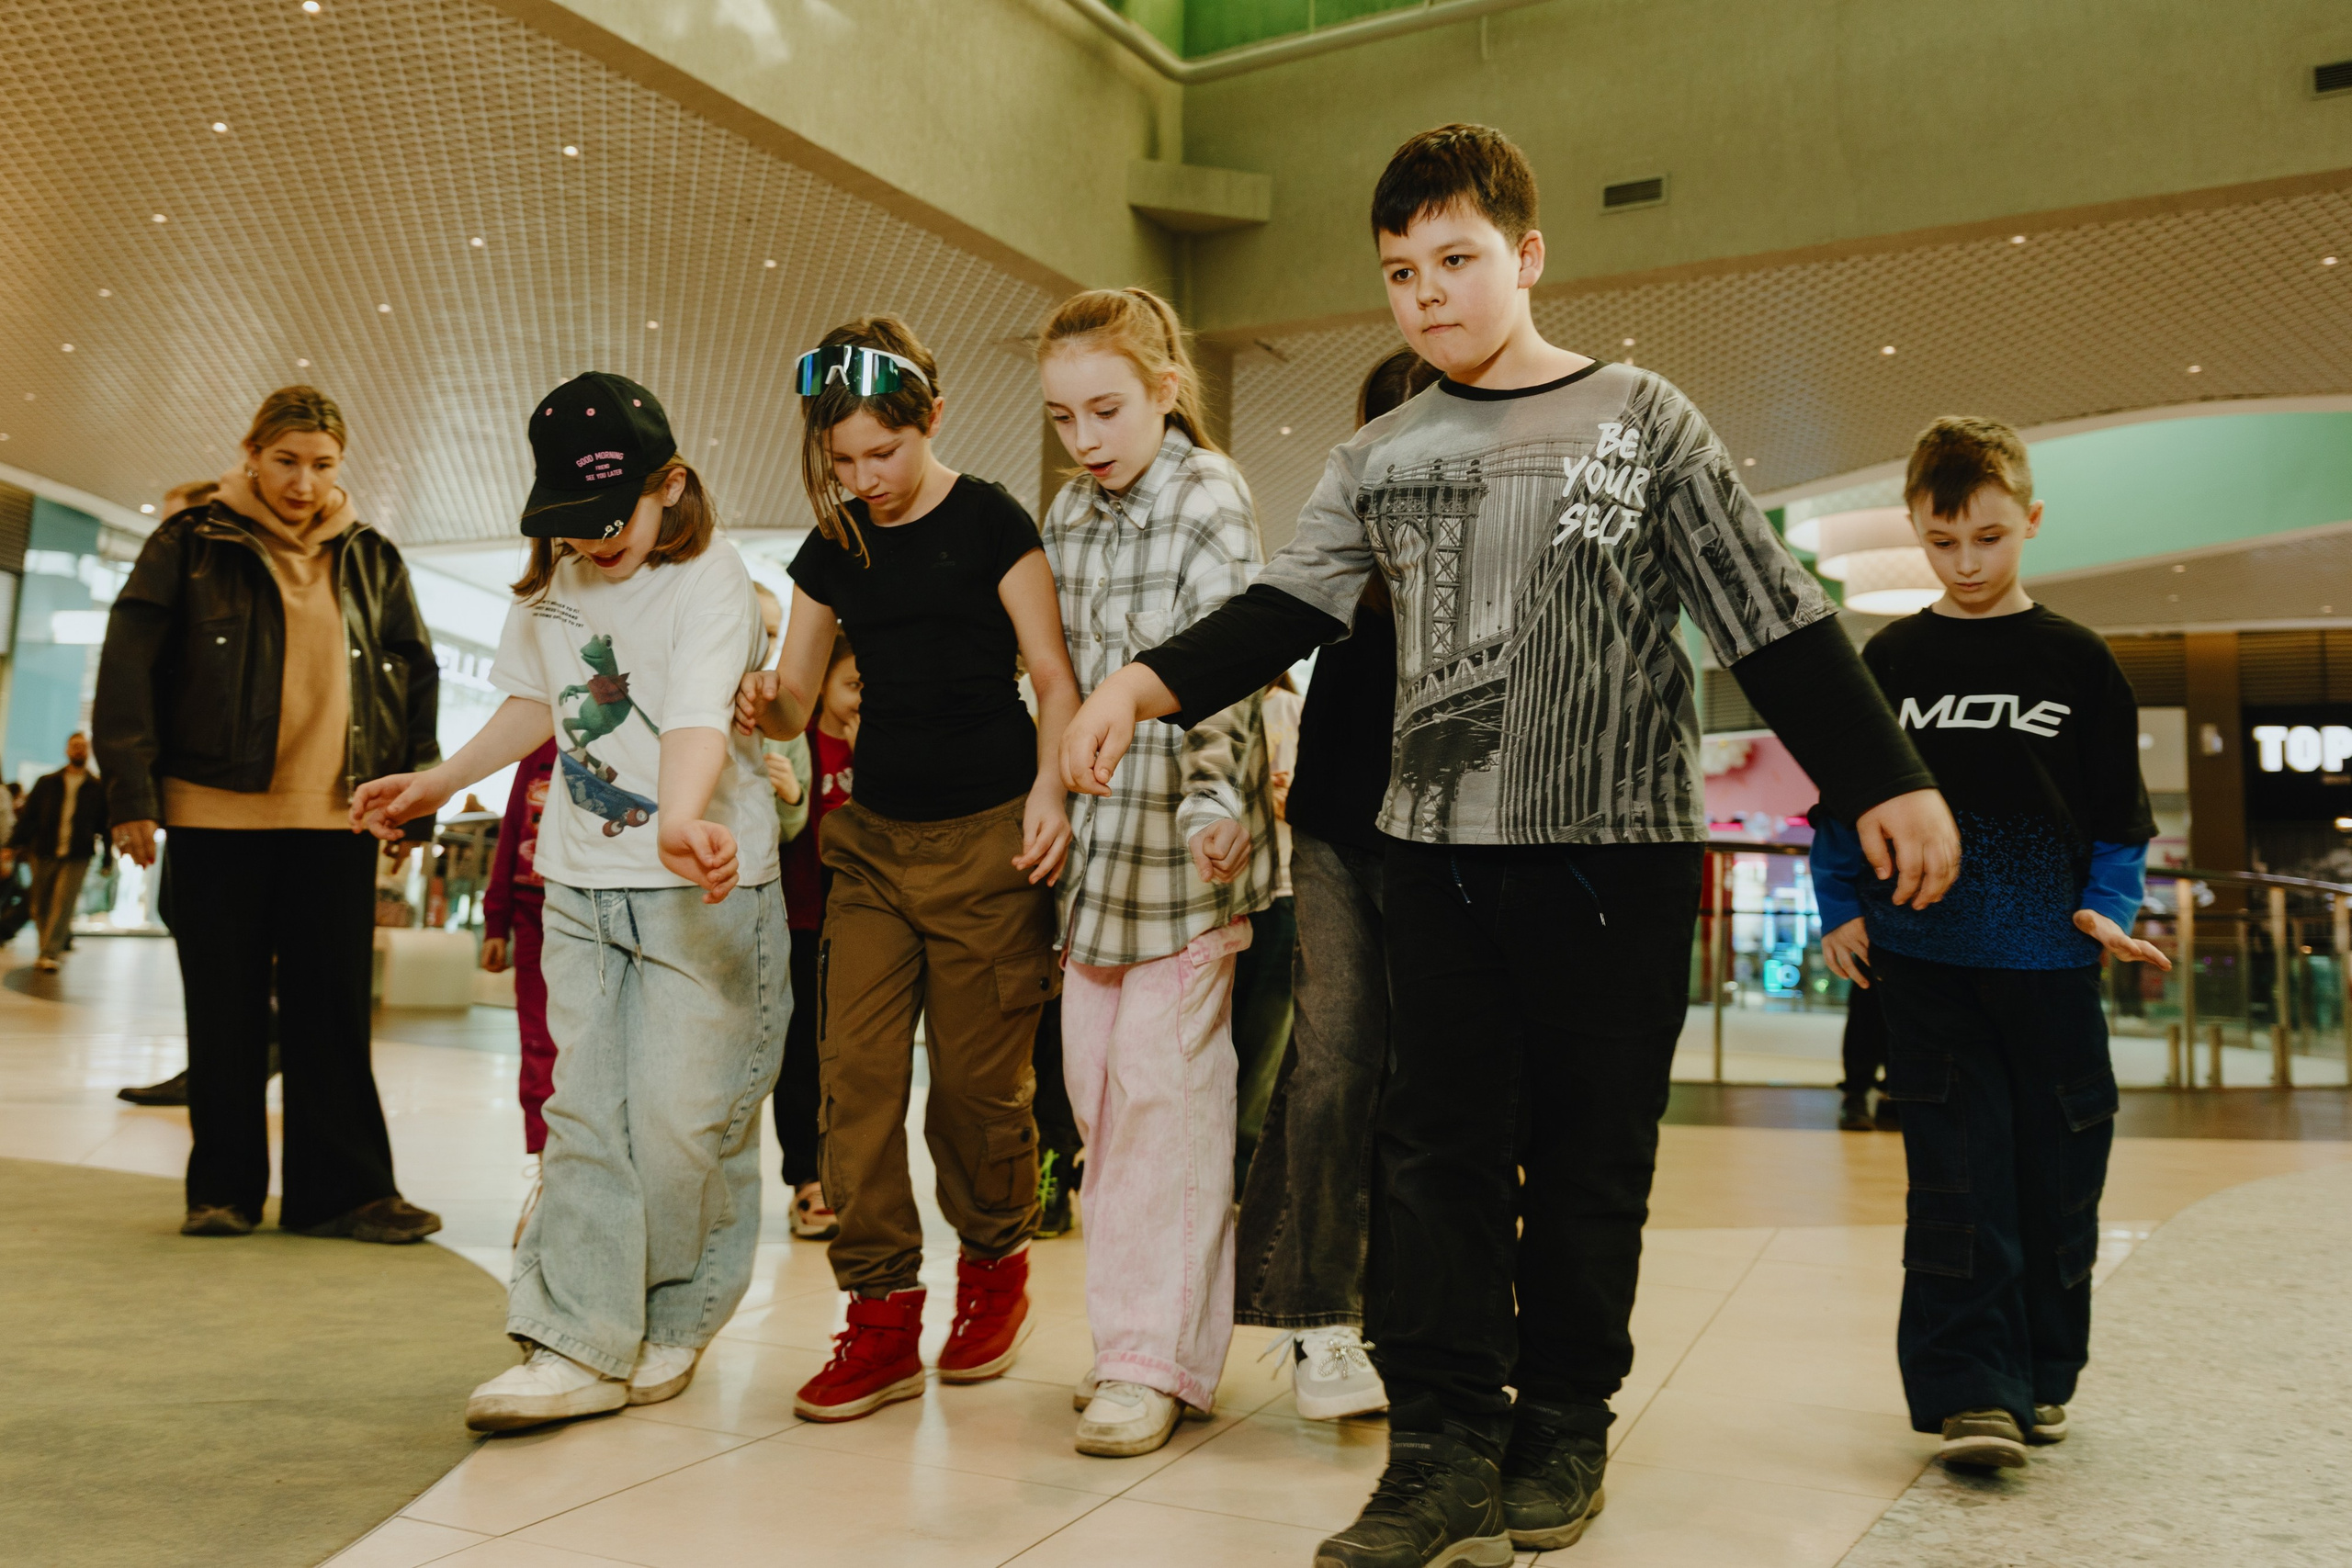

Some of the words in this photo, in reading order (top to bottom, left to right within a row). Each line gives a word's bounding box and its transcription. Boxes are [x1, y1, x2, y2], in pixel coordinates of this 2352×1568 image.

[575, 455, 594, 468] GOOD
[594, 451, 624, 460] MORNING
[1596, 422, 1640, 458] BE
[607, 468, 623, 478] LATER
[1562, 455, 1651, 508] YOUR
[1552, 502, 1643, 547] SELF
[1898, 694, 2072, 738] MOVE
